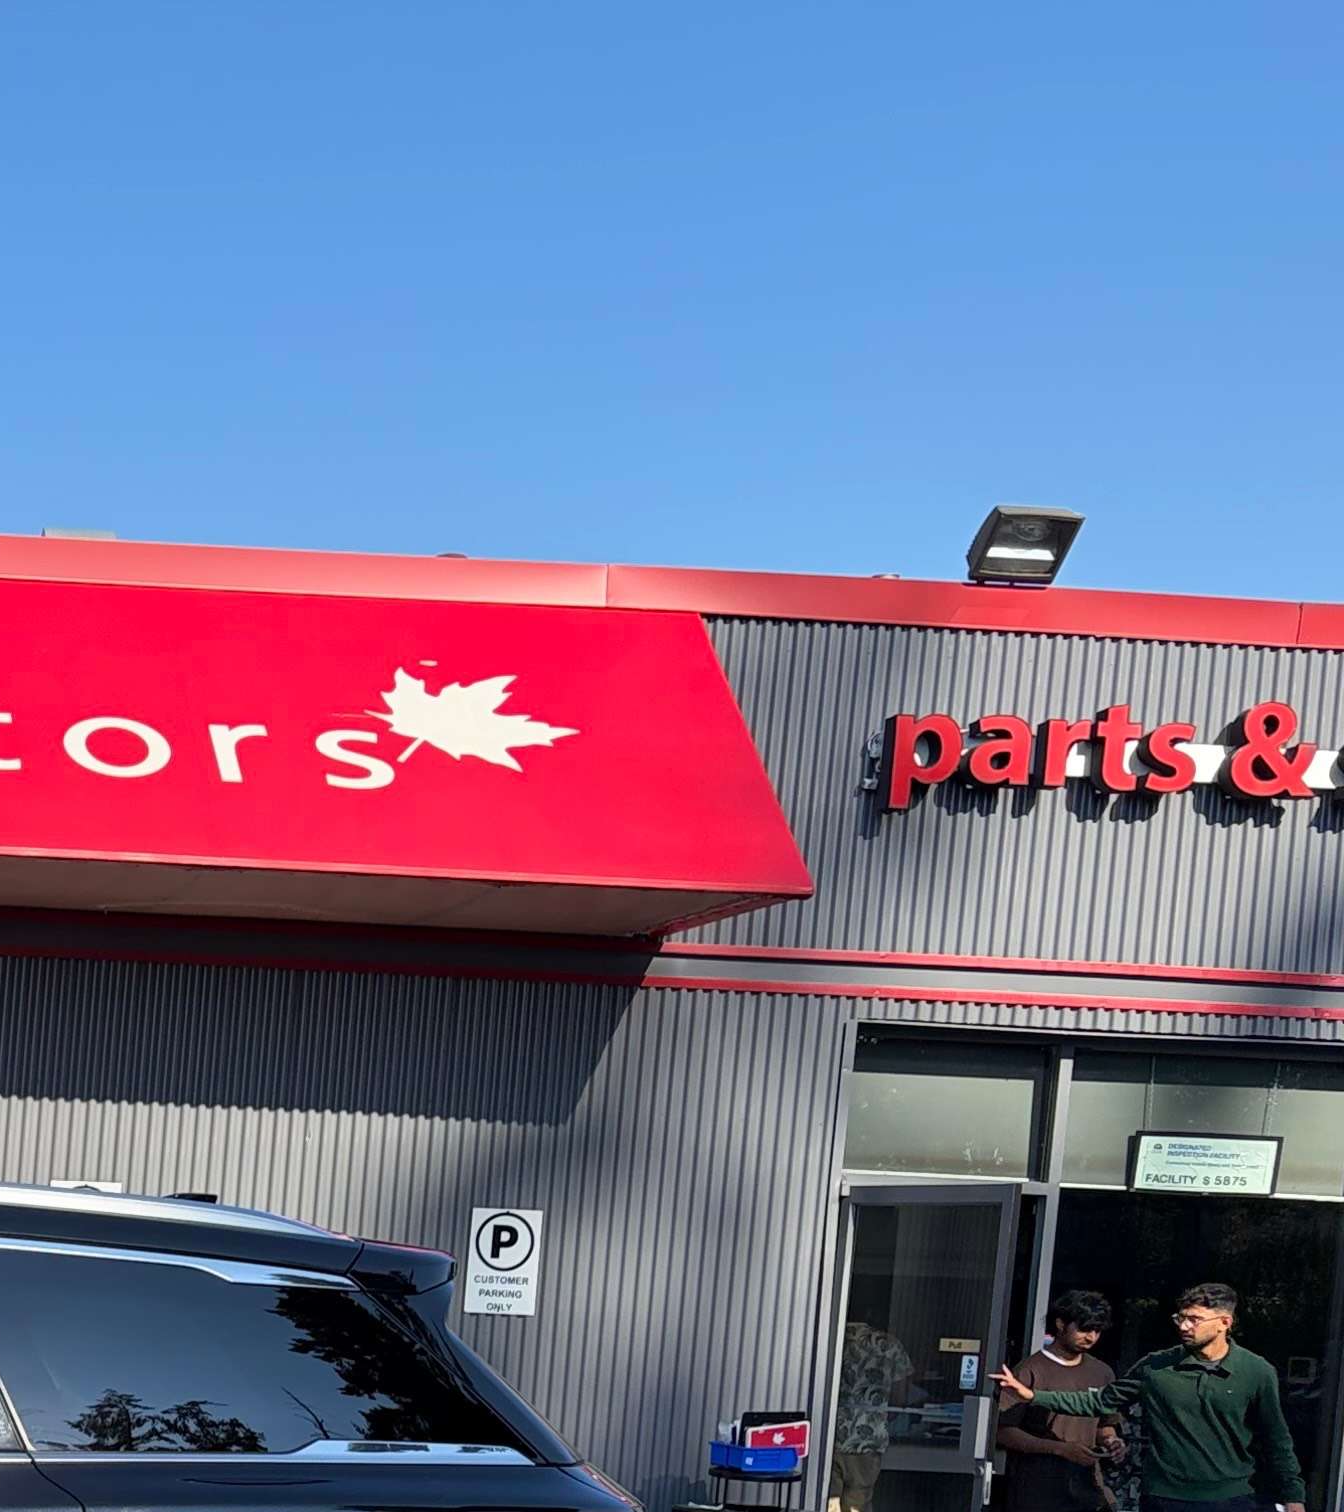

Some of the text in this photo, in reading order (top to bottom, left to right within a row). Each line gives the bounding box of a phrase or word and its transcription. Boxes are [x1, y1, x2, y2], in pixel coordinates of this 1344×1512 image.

[886, 700, 1317, 809] parts &
[1145, 1173, 1197, 1185] FACILITY
[1214, 1175, 1248, 1187] 5875
[490, 1224, 519, 1259] P
[474, 1274, 529, 1286] CUSTOMER
[478, 1288, 523, 1299] PARKING
[486, 1302, 513, 1313] ONLY
